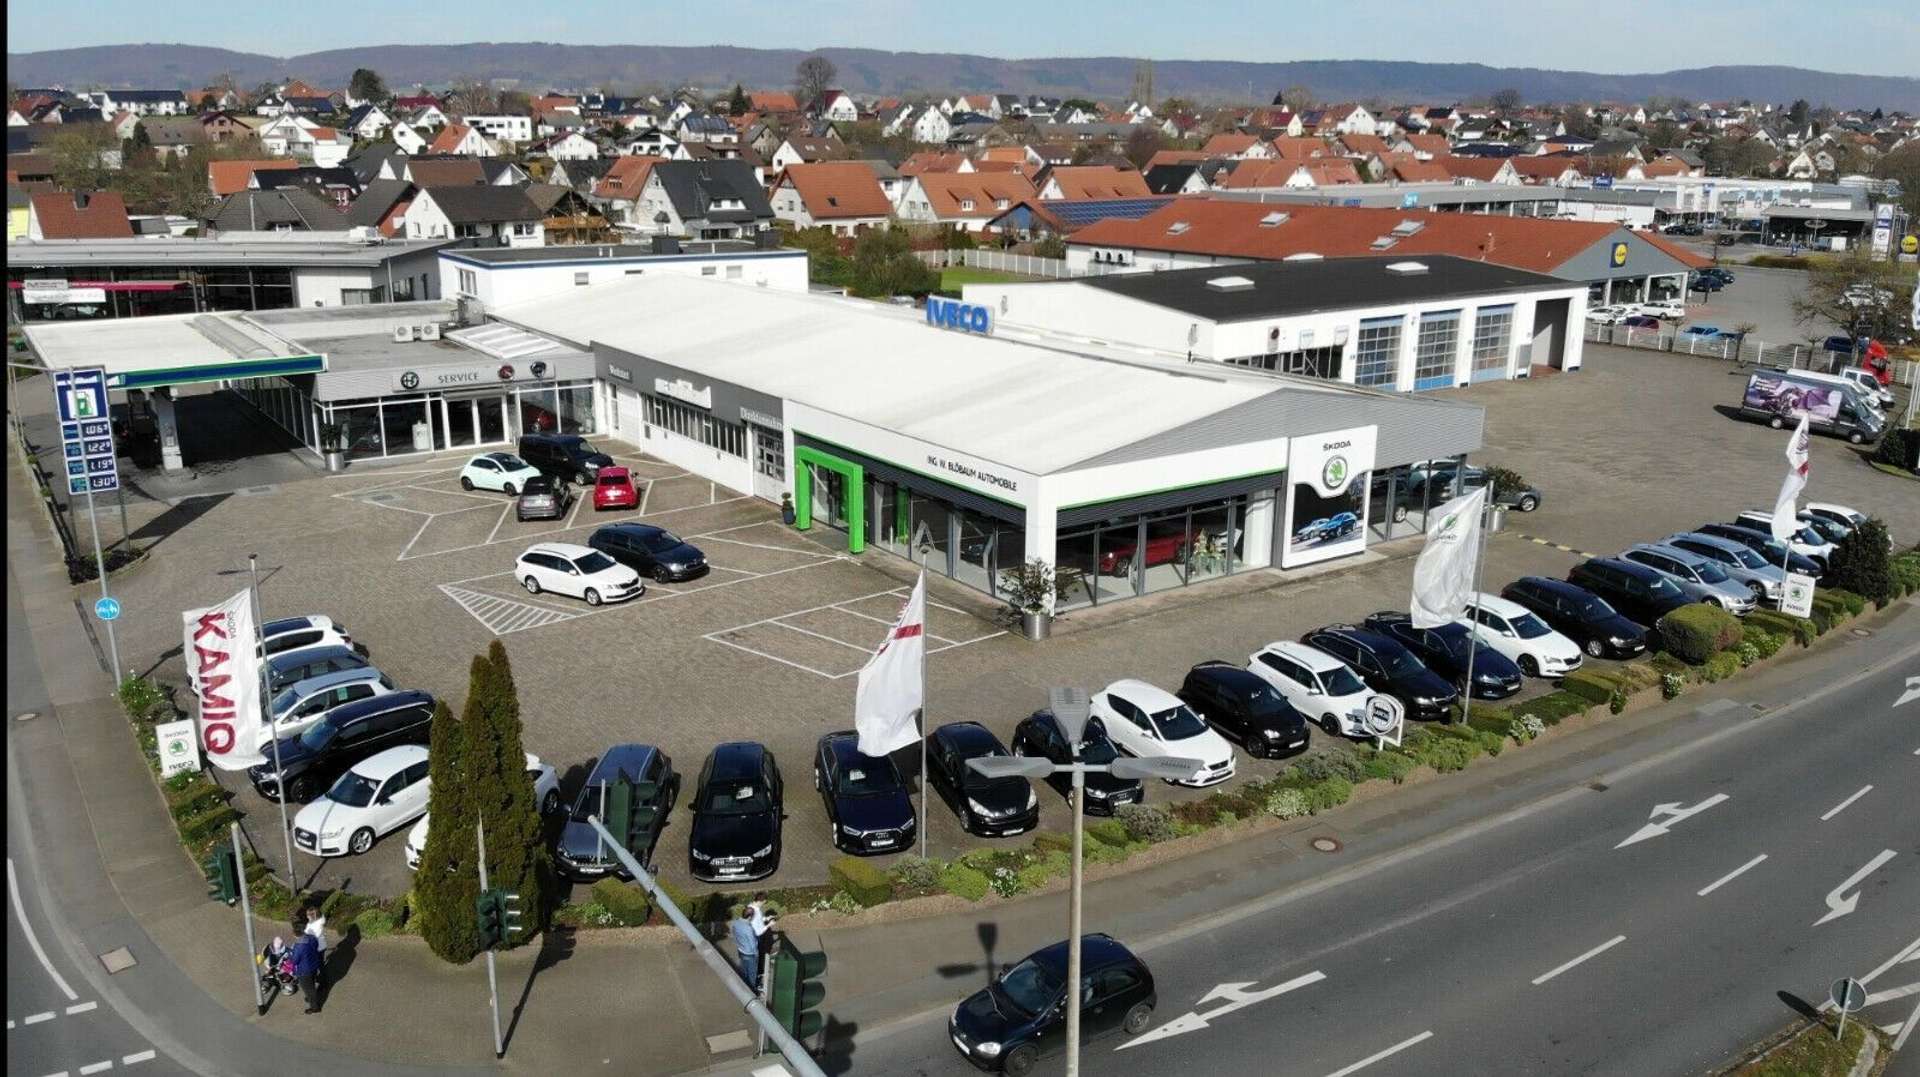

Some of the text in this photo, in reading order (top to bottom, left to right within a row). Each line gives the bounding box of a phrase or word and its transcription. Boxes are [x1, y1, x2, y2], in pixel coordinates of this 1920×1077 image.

[927, 298, 988, 332] IVECO
[438, 372, 479, 384] SERVICE
[977, 471, 1017, 492] AUTOMOBILE
[193, 612, 236, 755] KAMIQ
